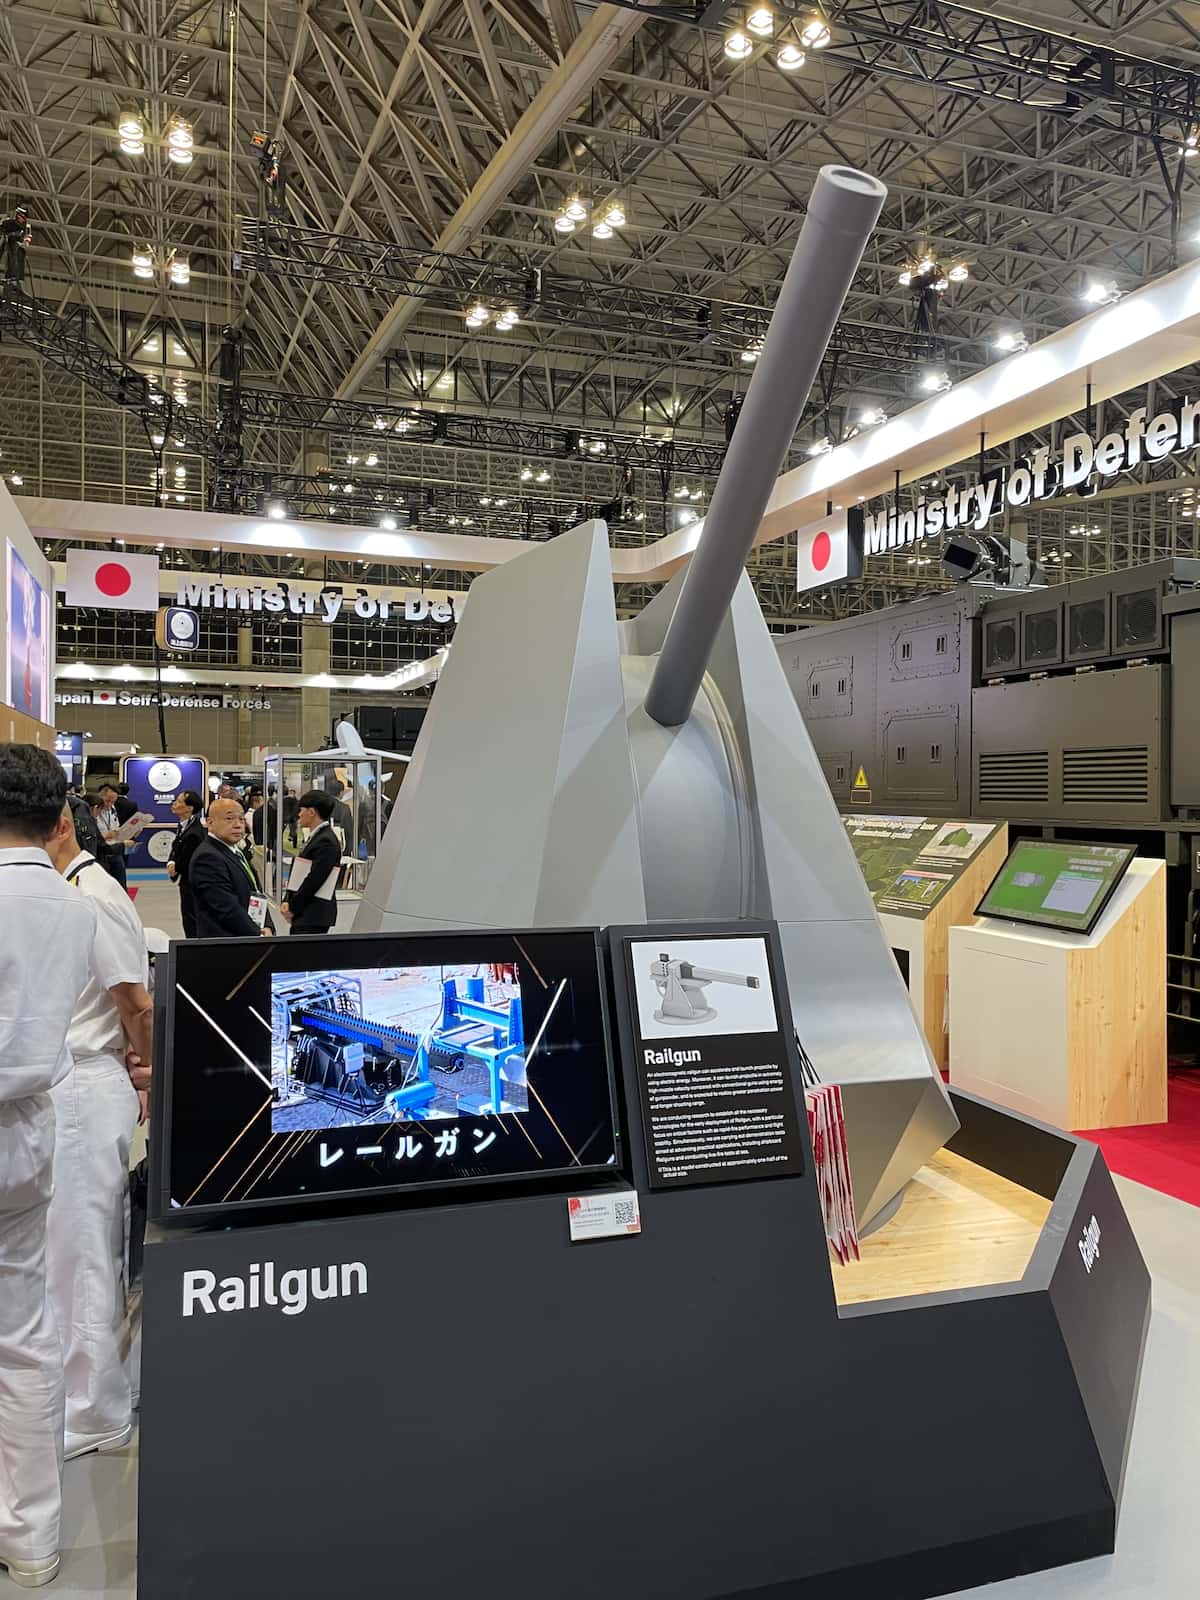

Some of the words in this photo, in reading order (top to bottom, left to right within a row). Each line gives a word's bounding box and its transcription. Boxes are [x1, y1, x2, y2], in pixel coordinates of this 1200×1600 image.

[864, 478, 997, 556] Ministry
[1006, 447, 1051, 506] of
[177, 580, 343, 622] Ministry
[355, 589, 394, 619] of
[54, 693, 91, 706] apan
[222, 694, 272, 710] Forces
[643, 1048, 702, 1066] Railgun
[319, 1127, 497, 1168] レールガン
[182, 1260, 369, 1317] Railgun
